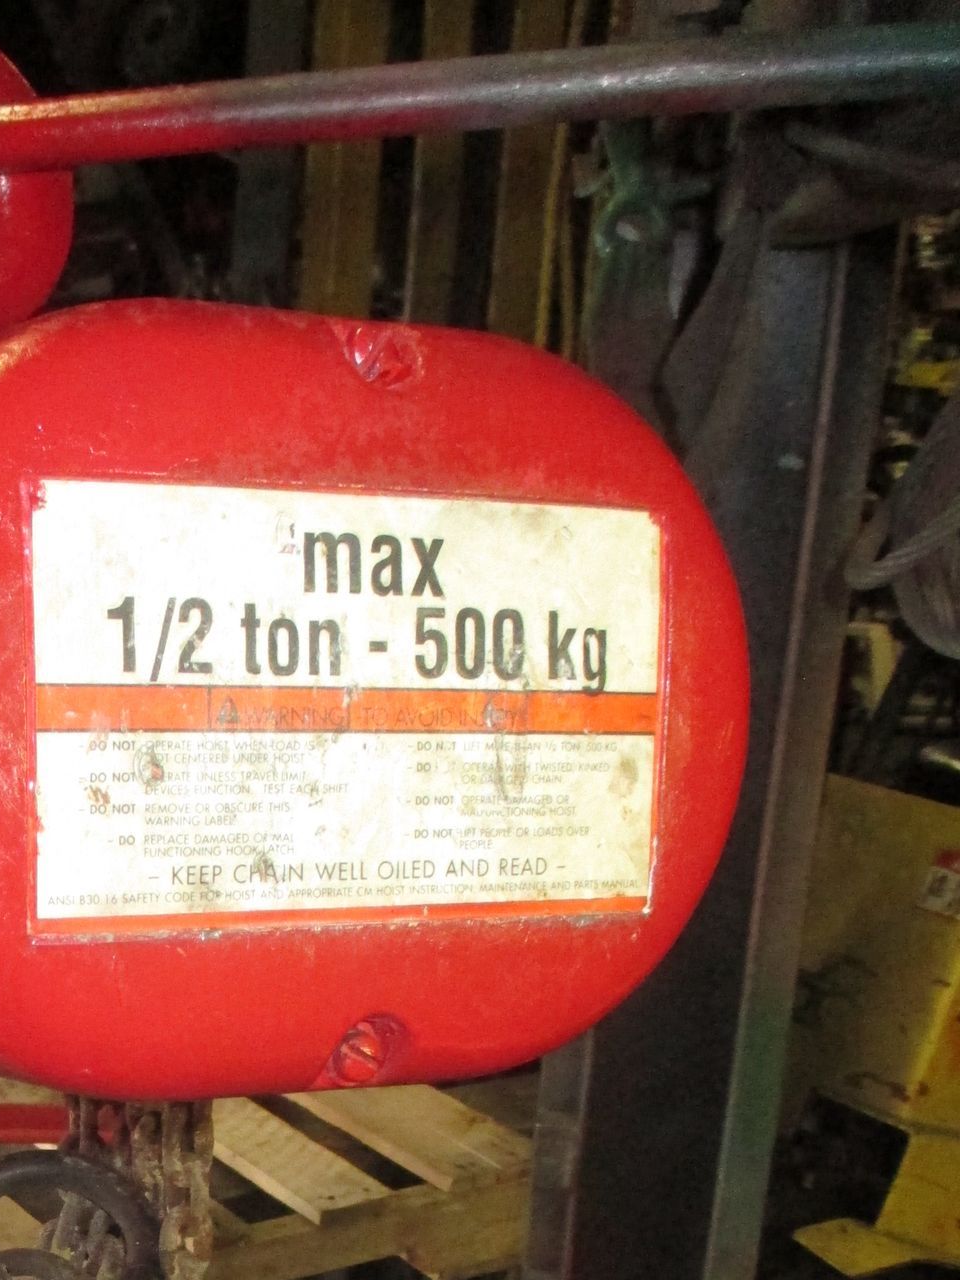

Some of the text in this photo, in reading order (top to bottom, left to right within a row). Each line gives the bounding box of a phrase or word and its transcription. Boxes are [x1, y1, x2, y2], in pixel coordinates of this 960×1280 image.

[304, 532, 445, 598] max
[107, 597, 213, 682] 1/2
[241, 603, 340, 677] ton
[415, 607, 524, 681] 500
[548, 611, 608, 695] kg
[88, 741, 107, 752] DO
[113, 741, 135, 752] NOT
[416, 740, 432, 752] DO
[233, 752, 269, 764] UNDER
[273, 752, 305, 764] HOIST
[416, 761, 432, 772] DO
[89, 772, 107, 783] DO
[112, 772, 136, 783] NOT
[197, 771, 237, 783] UNLESS
[263, 783, 285, 795] TEST
[323, 783, 349, 794] SHIFT
[415, 795, 430, 806] DO
[434, 795, 454, 805] NOT
[90, 802, 291, 815] DO NOT REMOVE OR OBSCURE THIS
[145, 815, 201, 826] WARNING
[118, 834, 136, 846] DO
[144, 833, 190, 846] REPLACE
[193, 833, 250, 845] DAMAGED
[414, 828, 429, 839] DO
[432, 828, 453, 839] NOT
[143, 845, 222, 858] FUNCTIONING
[226, 845, 257, 857] HOOK
[171, 864, 223, 886] KEEP
[233, 862, 304, 884] CHAIN
[315, 861, 368, 882] WELL
[377, 859, 436, 881] OILED
[445, 858, 490, 878] AND
[499, 856, 548, 877] READ
[48, 895, 76, 906] ANSI
[122, 892, 162, 904] SAFETY
[165, 891, 197, 903] CODE
[225, 889, 256, 901] HOIST
[288, 886, 353, 899] APPROPRIATE
[356, 885, 373, 897] CM
[376, 884, 405, 897] HOIST
[479, 881, 547, 893] MAINTENANCE
